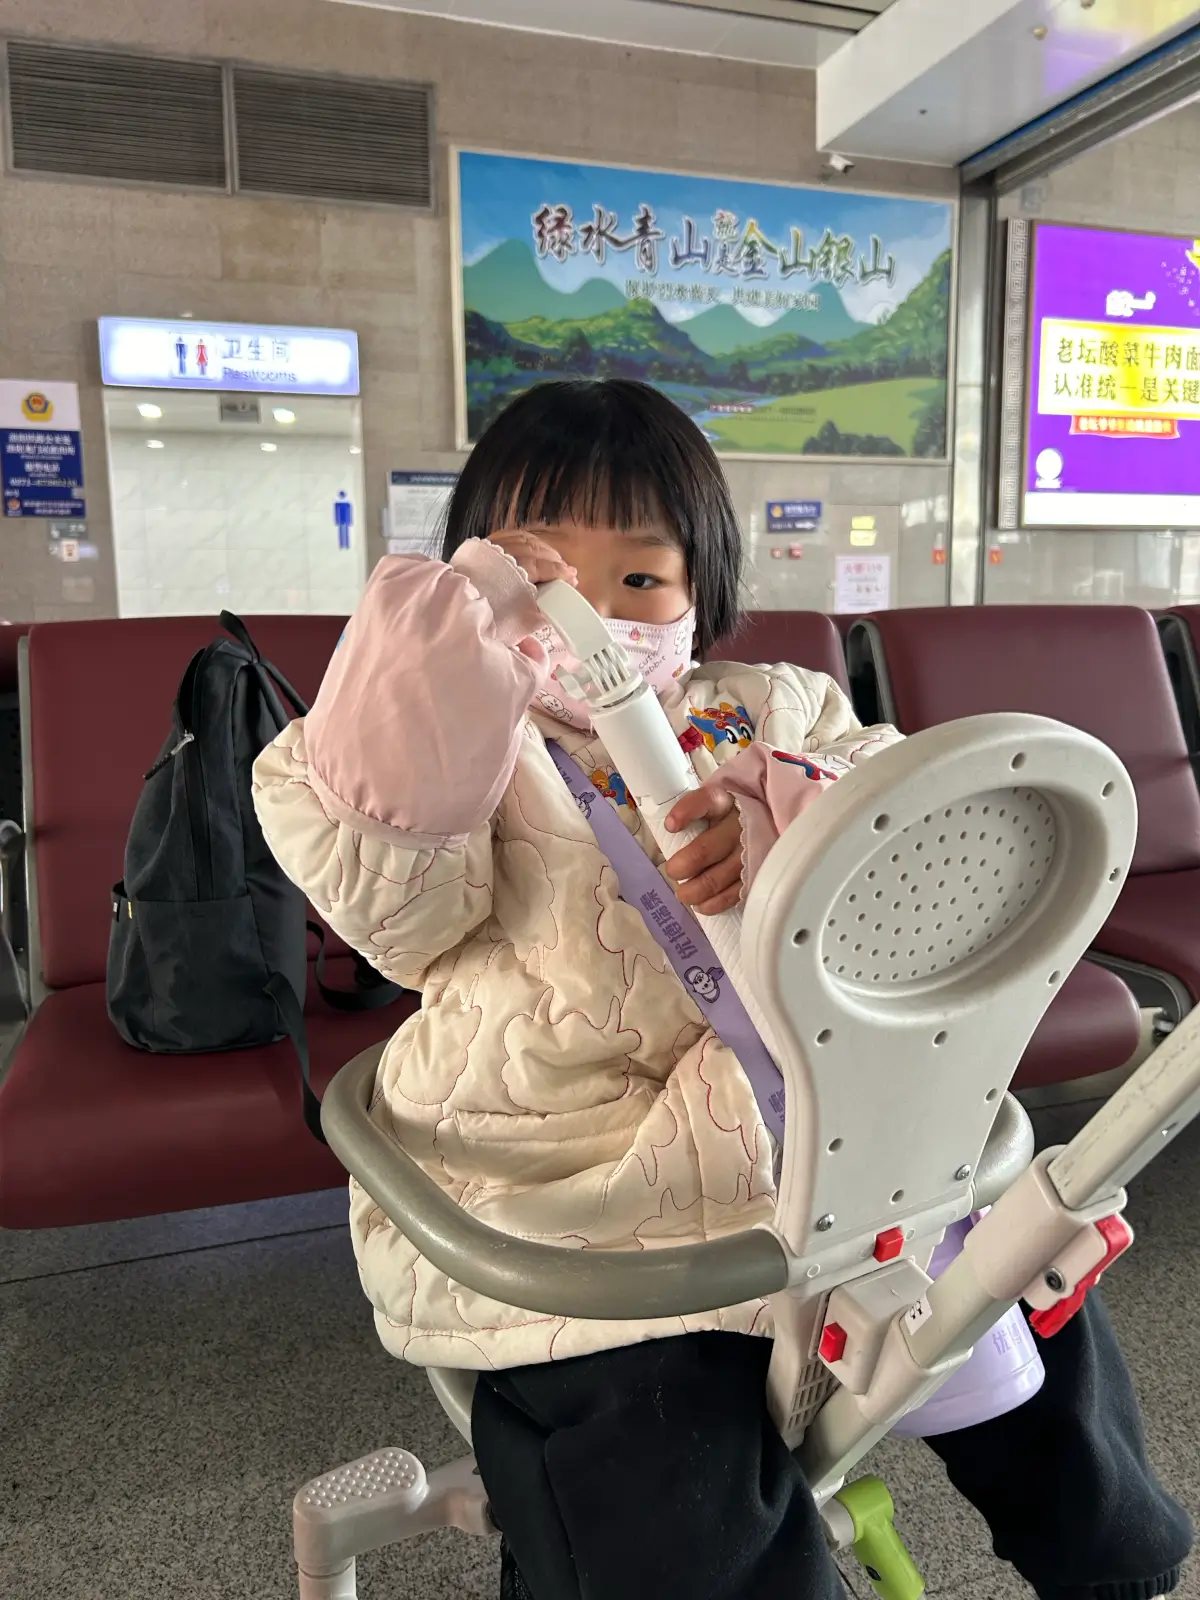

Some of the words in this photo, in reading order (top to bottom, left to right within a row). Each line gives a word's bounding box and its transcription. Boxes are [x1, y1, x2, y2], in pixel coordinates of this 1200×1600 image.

[221, 338, 291, 363] 卫生间
[1057, 337, 1200, 371] 老坛酸菜牛肉面
[1053, 372, 1200, 404] 认准统一是关键
